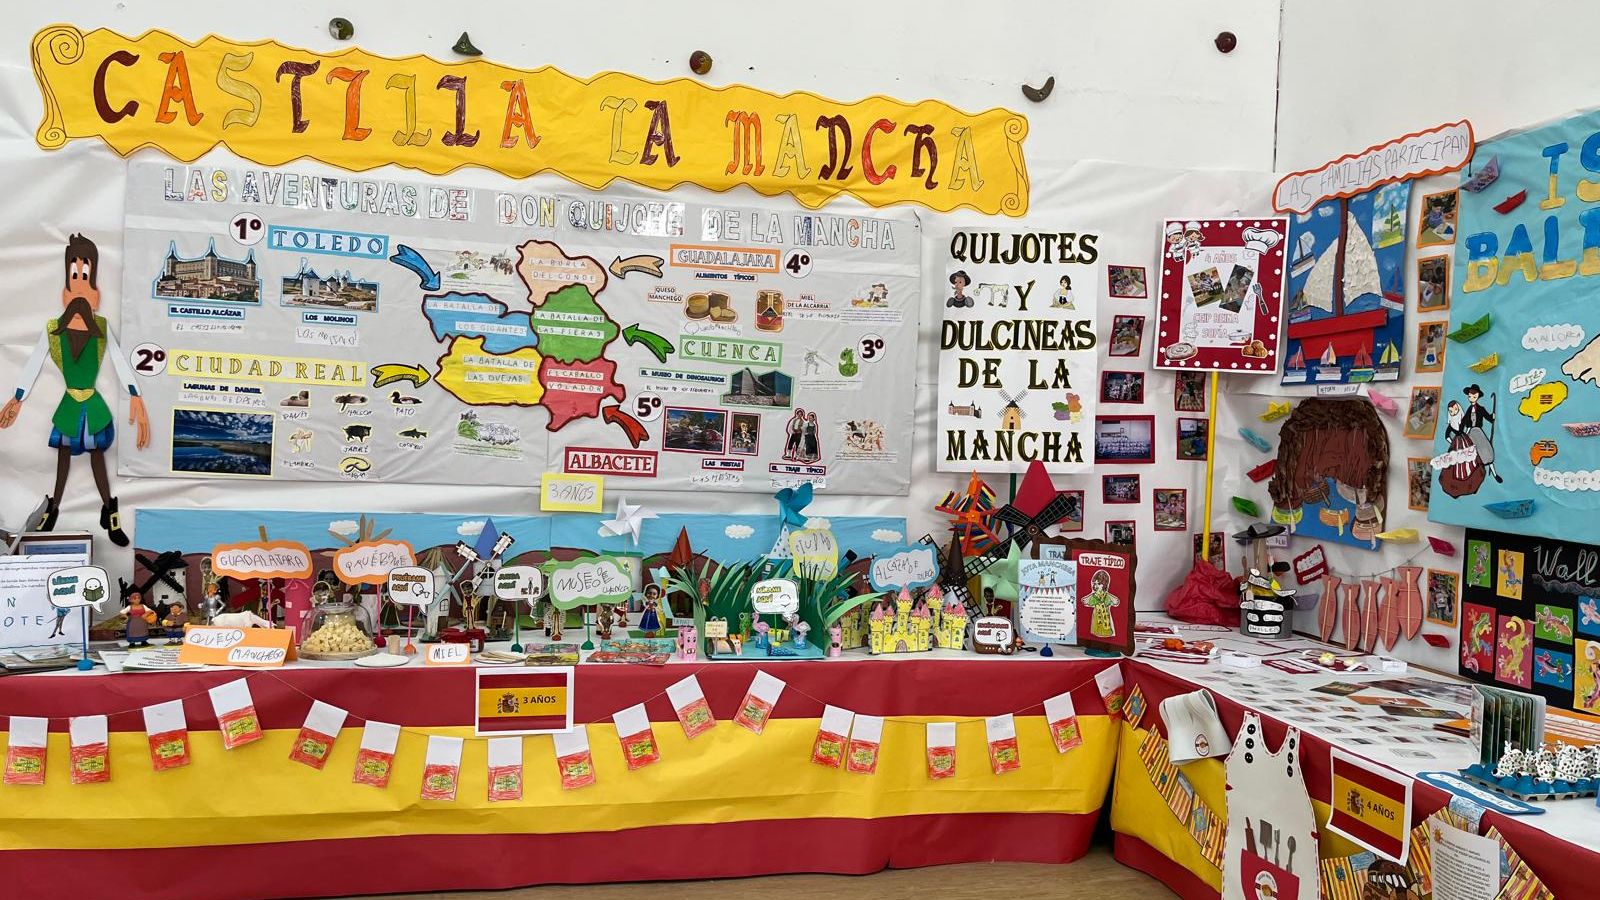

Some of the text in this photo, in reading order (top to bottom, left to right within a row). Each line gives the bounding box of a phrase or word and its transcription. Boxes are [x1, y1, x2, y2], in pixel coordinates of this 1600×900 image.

[600, 96, 681, 168] LA
[725, 110, 986, 192] MANCHA
[165, 170, 896, 249] LAS AVENTURAS DE DON QUIJOTE DE LA MANCHA
[274, 229, 384, 255] TOLEDO
[951, 231, 1099, 265] QUIJOTES
[677, 249, 774, 268] GUADALAJARA
[695, 272, 728, 280] ALIMENTOS
[649, 294, 682, 302] MANCHEGO
[1014, 279, 1036, 311] Y
[180, 307, 210, 315] CASTILLO
[211, 307, 242, 317] ALCÁZAR
[324, 315, 354, 323] MOLINOS
[940, 318, 1097, 351] DULCINEAS
[684, 340, 776, 361] CUENCA
[175, 354, 363, 382] CIUDAD REAL
[958, 358, 1073, 390] DE LA
[945, 429, 1085, 463] MANCHA
[570, 453, 651, 471] ALBACETE
[551, 484, 594, 500] 3 AÑOS
[1080, 555, 1124, 567] TRAJE TÍPICO
[189, 629, 243, 648] QUESO
[231, 647, 286, 661] MANCHEGO
[433, 646, 462, 659] MIEL
[523, 695, 556, 704] 3 AÑOS
[1366, 800, 1395, 821] 4 AÑOS
